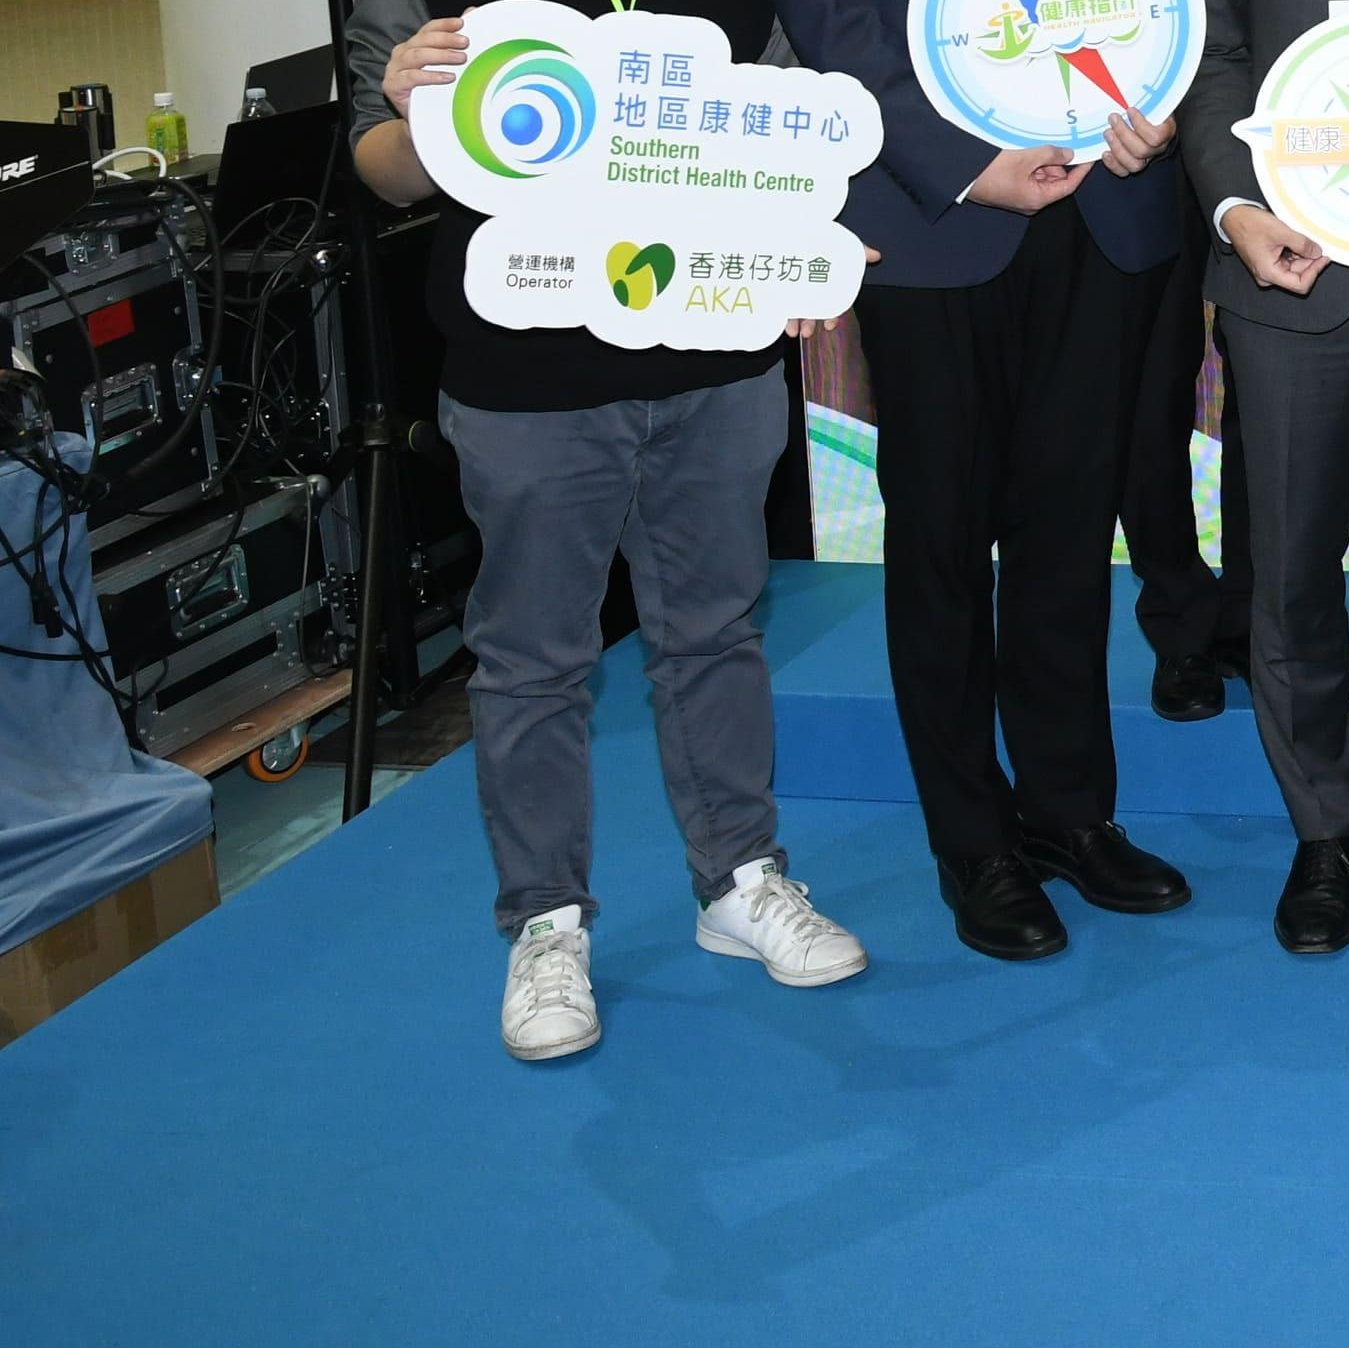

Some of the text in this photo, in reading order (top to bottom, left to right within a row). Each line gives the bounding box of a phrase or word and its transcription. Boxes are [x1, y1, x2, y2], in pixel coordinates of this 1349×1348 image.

[1150, 4, 1161, 19] E
[951, 33, 970, 47] W
[617, 50, 695, 88] 南區
[612, 92, 850, 143] 地區康健中心
[1067, 110, 1078, 125] S
[609, 136, 701, 161] Southern
[1285, 125, 1342, 154] 健康
[0, 155, 36, 182] RE
[606, 161, 815, 194] District Health Centre
[507, 254, 576, 272] 營運機構
[687, 252, 833, 284] 香港仔坊會
[505, 274, 574, 291] Operator
[685, 285, 754, 314] AKA
